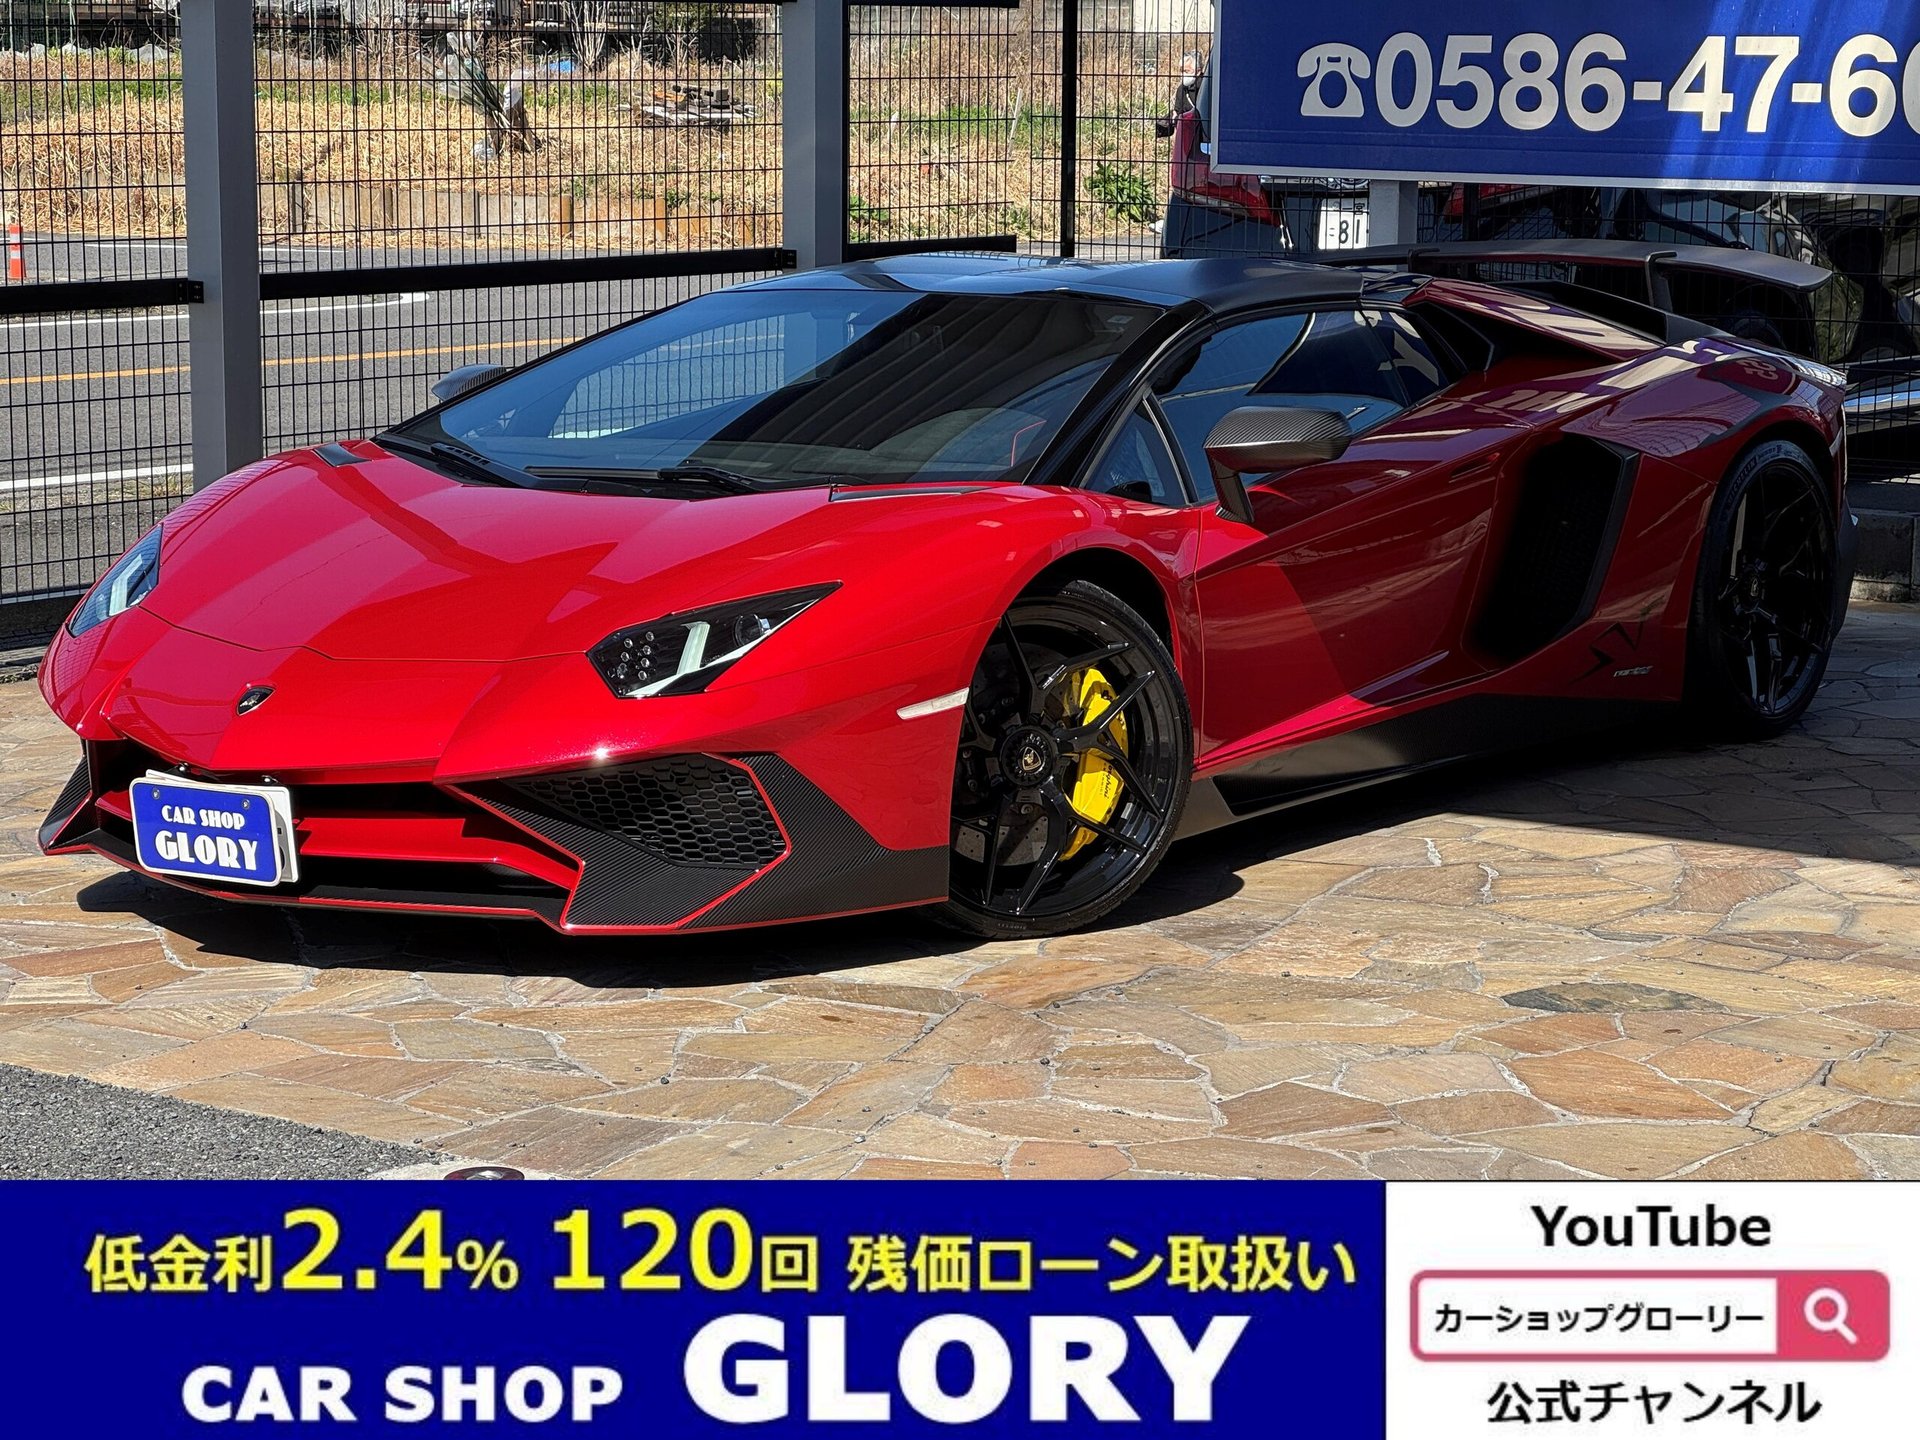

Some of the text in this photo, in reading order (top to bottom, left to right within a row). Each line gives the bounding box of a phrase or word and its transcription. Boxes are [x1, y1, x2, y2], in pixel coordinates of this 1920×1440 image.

[1375, 32, 1920, 137] 0586-47-6
[161, 804, 246, 831] CAR SHOP
[154, 829, 258, 872] GLORY
